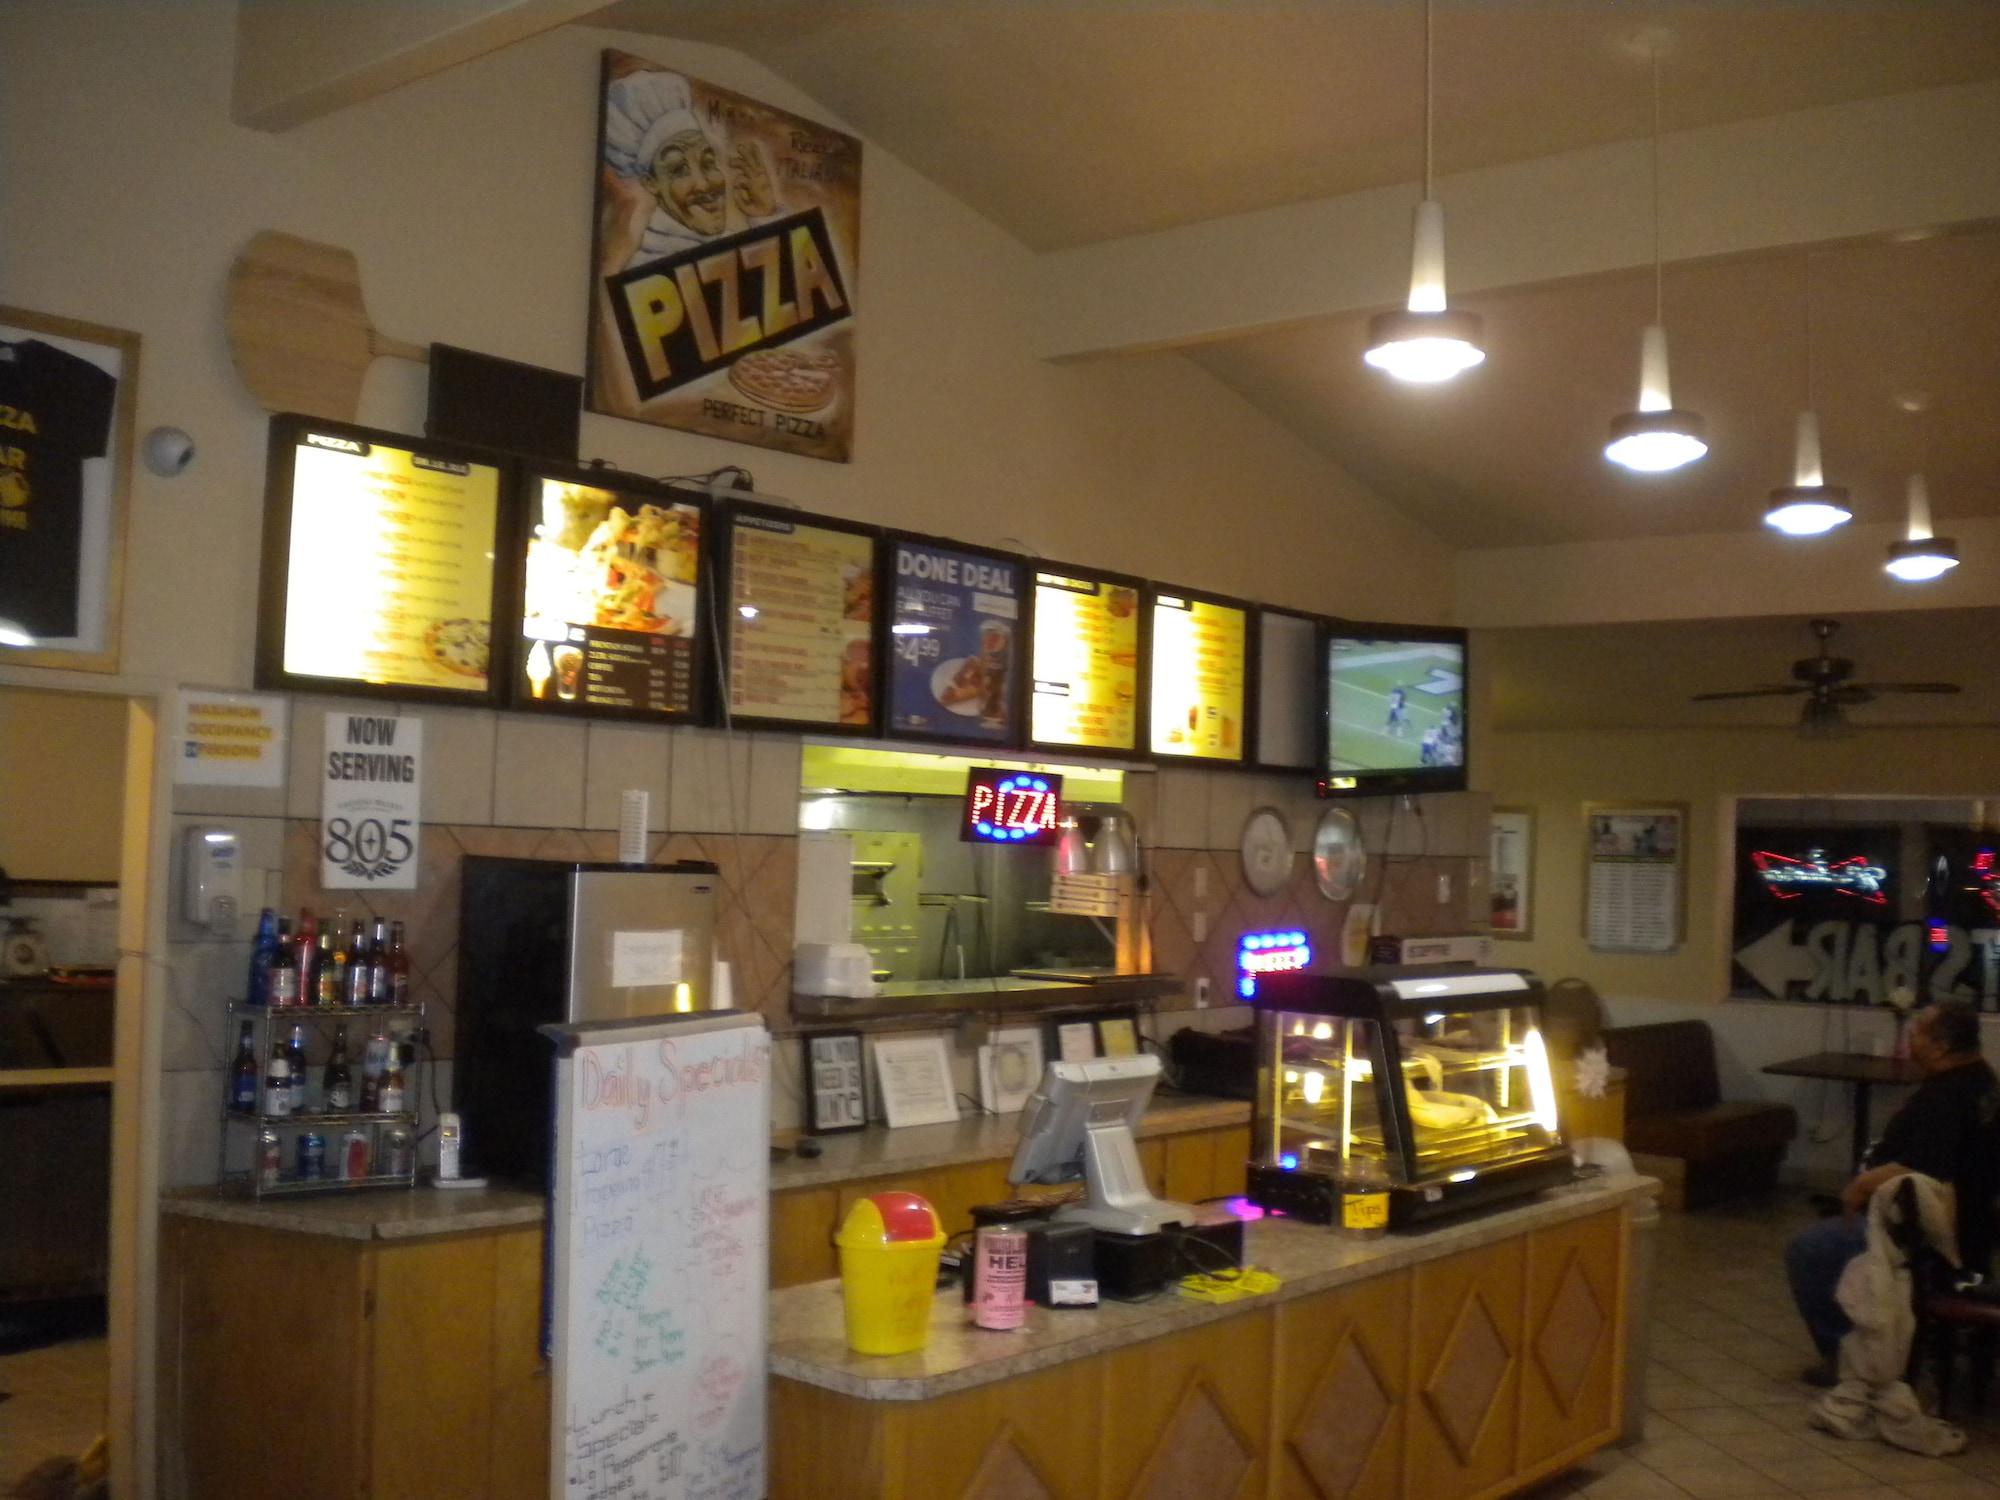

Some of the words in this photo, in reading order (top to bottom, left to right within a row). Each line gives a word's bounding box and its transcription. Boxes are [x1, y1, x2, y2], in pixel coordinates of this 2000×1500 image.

[624, 225, 843, 382] PIZZA
[704, 399, 766, 426] PERFECT
[775, 415, 826, 439] PIZZA
[898, 550, 959, 585] DONE
[962, 561, 1015, 594] DEAL
[347, 716, 396, 747] NOW
[328, 752, 415, 783] SERVING
[971, 785, 1056, 830] PIZZA
[325, 817, 414, 864] 805
